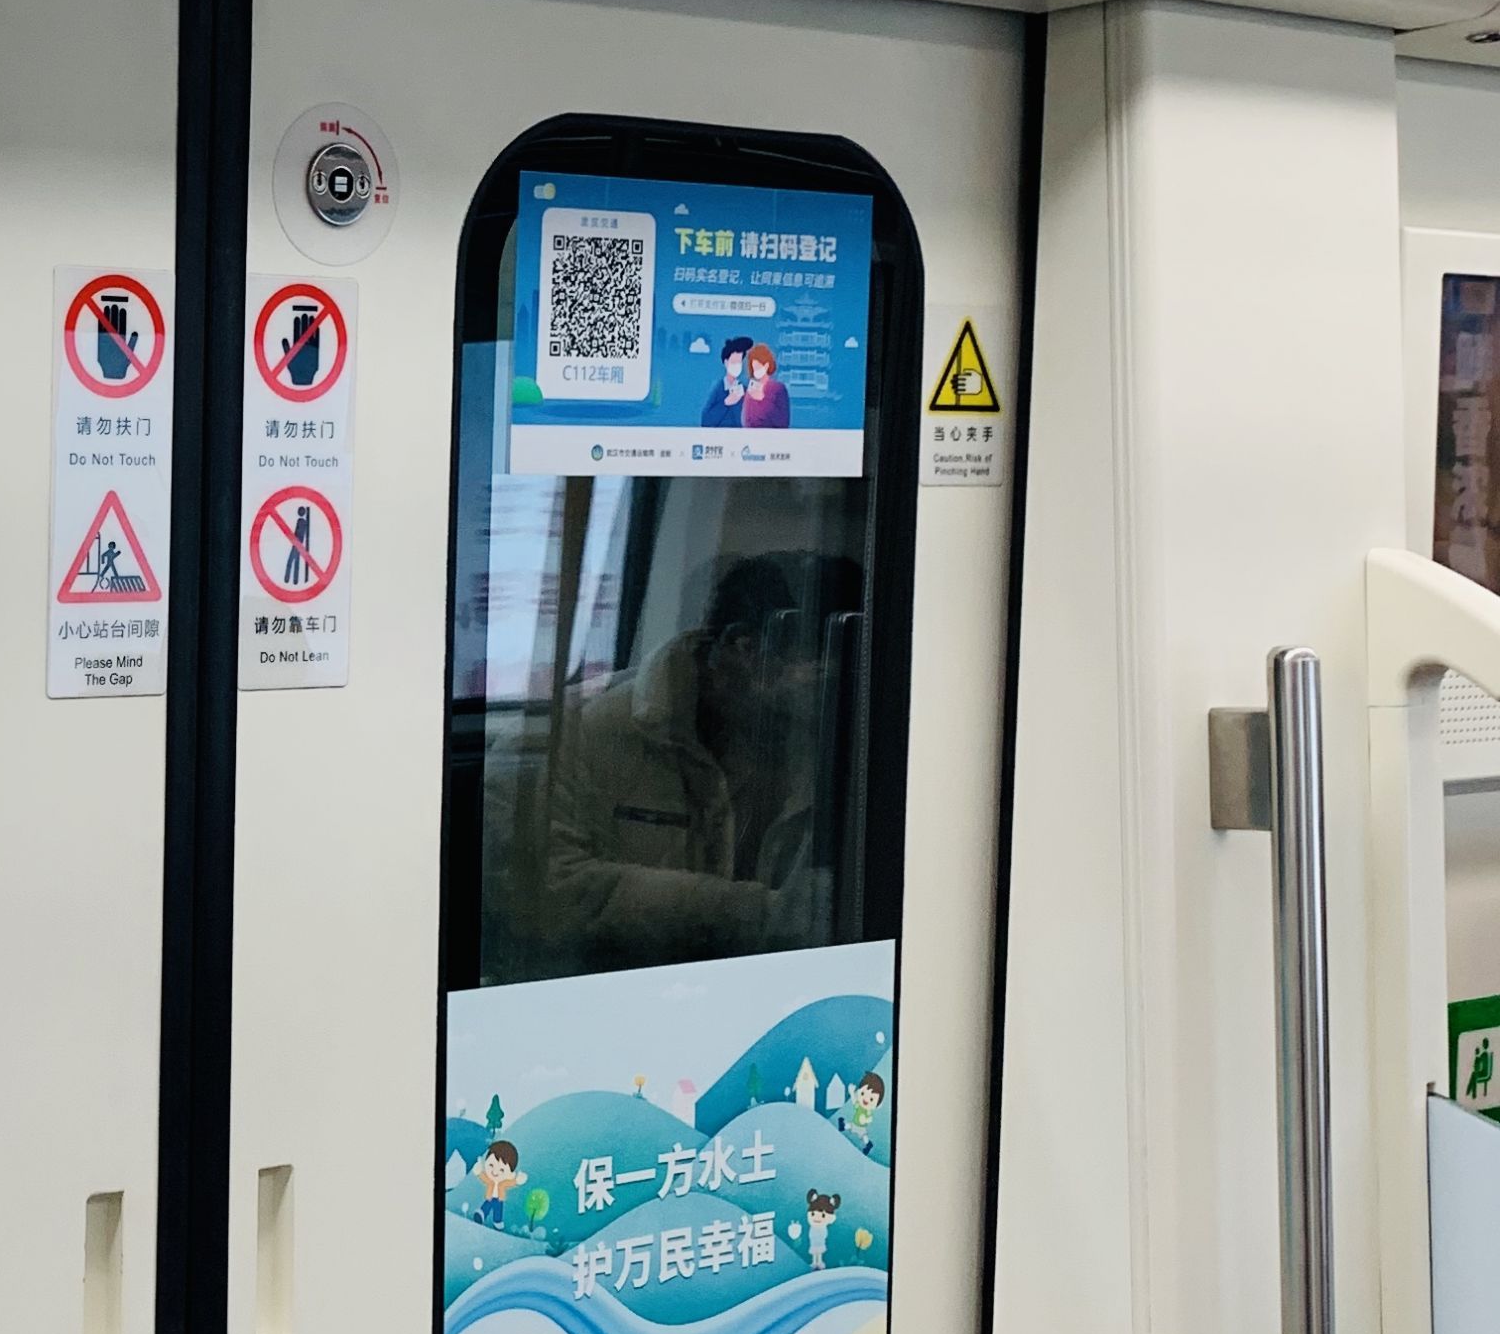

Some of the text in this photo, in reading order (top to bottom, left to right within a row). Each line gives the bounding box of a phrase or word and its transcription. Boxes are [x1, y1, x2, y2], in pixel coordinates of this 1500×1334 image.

[674, 228, 837, 263] 下车前 请扫码登记
[563, 365, 624, 385] C112车厢
[76, 417, 151, 436] 请勿扶门
[265, 420, 335, 439] 请勿扶门
[934, 426, 993, 442] 当心夹手
[69, 453, 156, 466] Do Not Touch
[258, 455, 339, 468] Do Not Touch
[935, 466, 967, 477] Pinching
[58, 619, 160, 640] 小心站台间隙
[254, 615, 337, 635] 请勿靠车门
[74, 655, 143, 670] Please Mind
[260, 650, 329, 664] Do Not Lean
[85, 673, 133, 688] The Gap
[573, 1130, 777, 1214] 保一方水土
[572, 1211, 776, 1300] 护万民幸福
